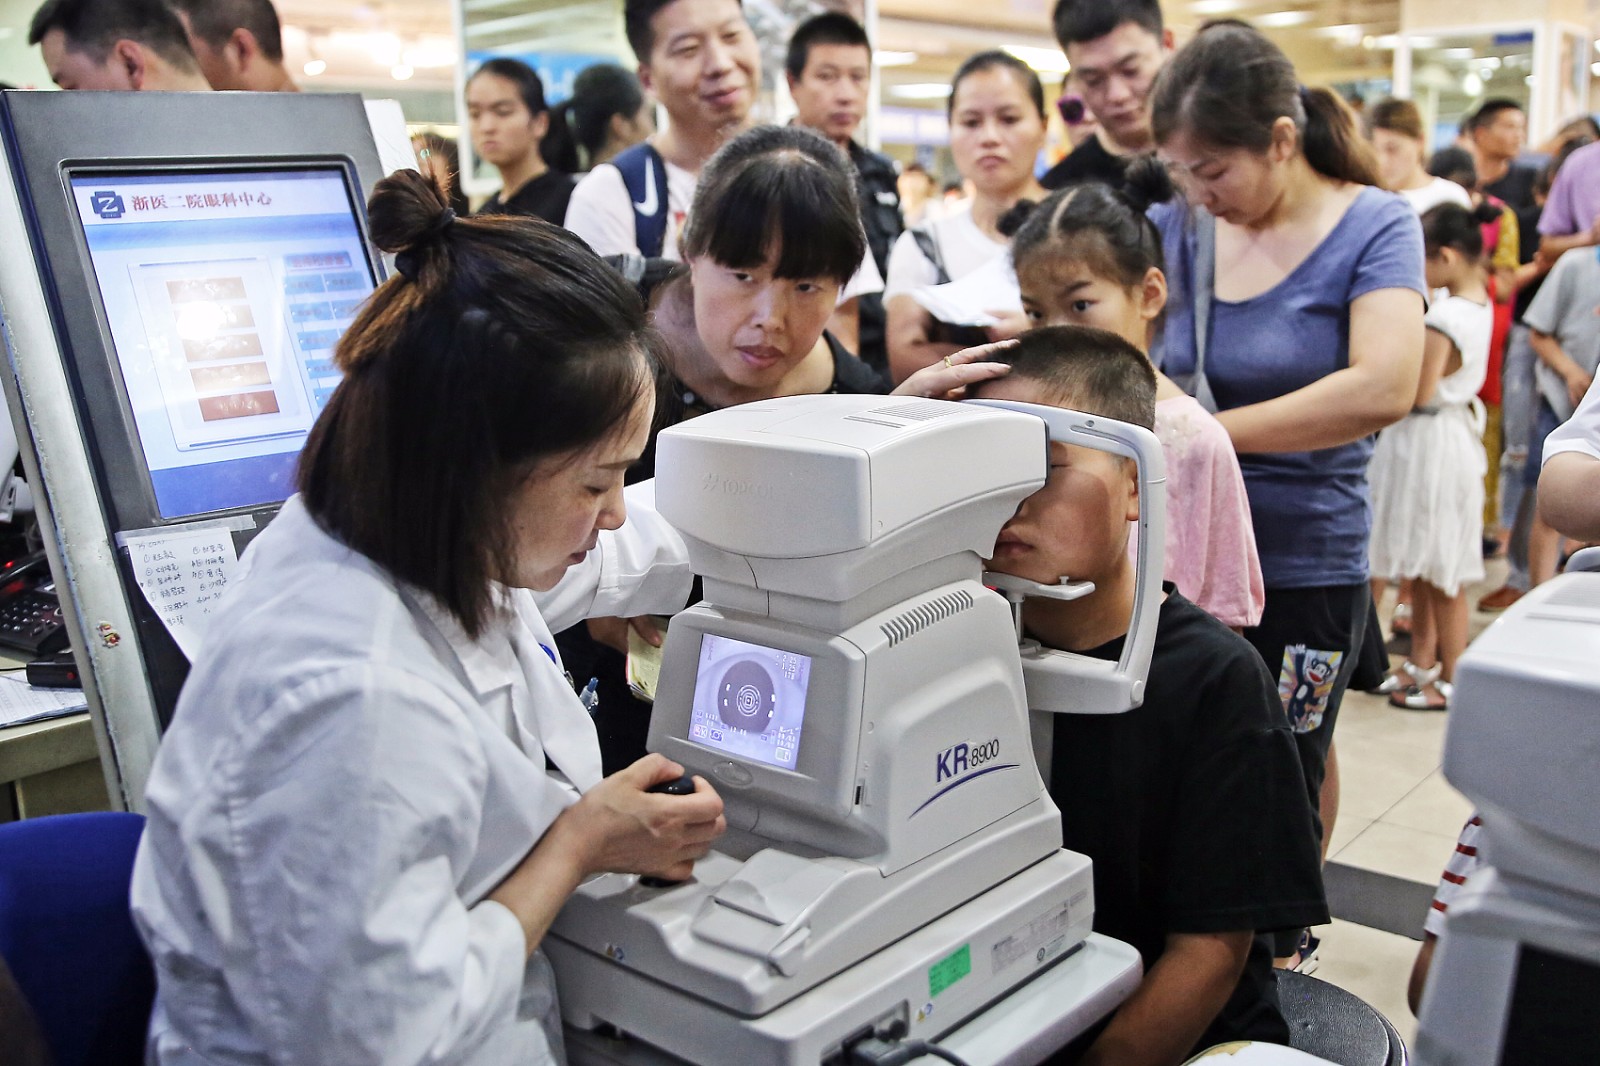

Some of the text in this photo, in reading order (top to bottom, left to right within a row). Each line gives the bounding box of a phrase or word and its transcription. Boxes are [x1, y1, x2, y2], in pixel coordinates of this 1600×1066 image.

[131, 190, 272, 212] 浙医二院眼科中心
